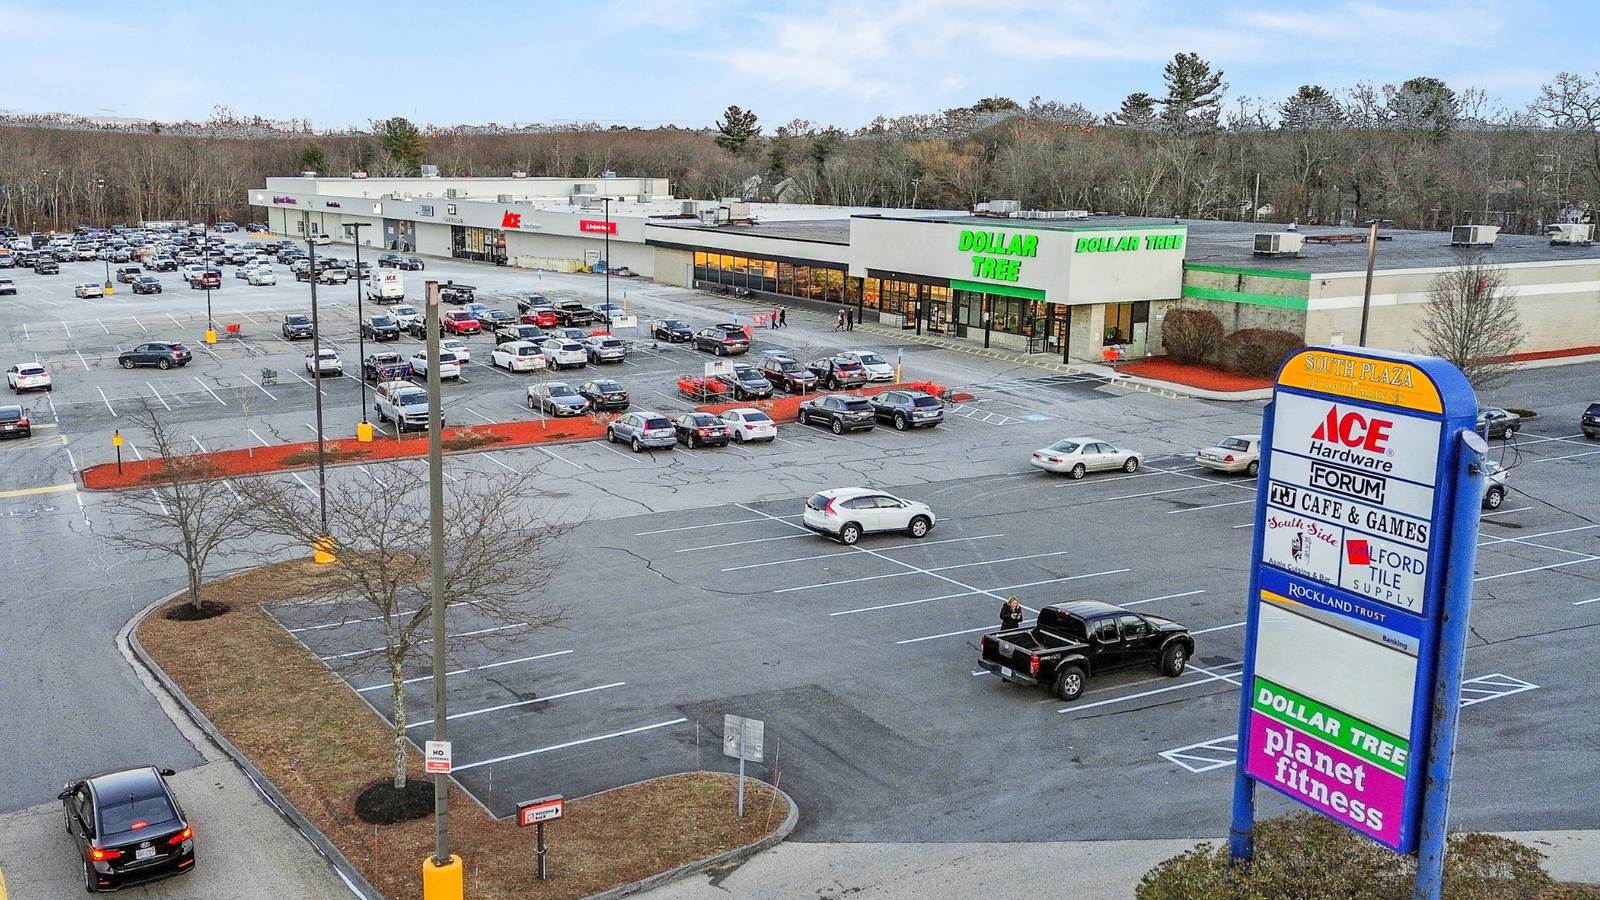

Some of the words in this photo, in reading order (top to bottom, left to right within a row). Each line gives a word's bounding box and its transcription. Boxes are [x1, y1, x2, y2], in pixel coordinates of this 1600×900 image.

[502, 210, 520, 228] ACE
[958, 230, 1039, 258] DOLLAR
[1076, 236, 1140, 253] DOLLAR
[1146, 235, 1184, 250] TREE
[972, 256, 1022, 282] TREE
[1304, 354, 1355, 378] SOUTH
[1360, 362, 1413, 388] PLAZA
[1323, 382, 1356, 394] SOUTH
[1312, 404, 1393, 454] ACE
[1309, 441, 1393, 472] Hardware
[1314, 468, 1381, 500] FORUM
[1272, 484, 1296, 508] TJ
[1302, 493, 1343, 520] CAFE
[1348, 506, 1360, 525] &
[1366, 511, 1428, 544] GAMES
[1268, 516, 1304, 529] South
[1307, 522, 1338, 547] Side
[1319, 574, 1330, 582] Bar
[1354, 580, 1415, 607] SUPPLY
[1369, 566, 1401, 590] TILE
[1288, 582, 1352, 613] ROCKLAND
[1354, 604, 1386, 622] TRUST
[1382, 634, 1408, 650] Banking
[1258, 688, 1341, 738] DOLLAR
[1350, 727, 1408, 767] TREE
[1263, 727, 1366, 792] planet
[1275, 756, 1383, 831] fitness
